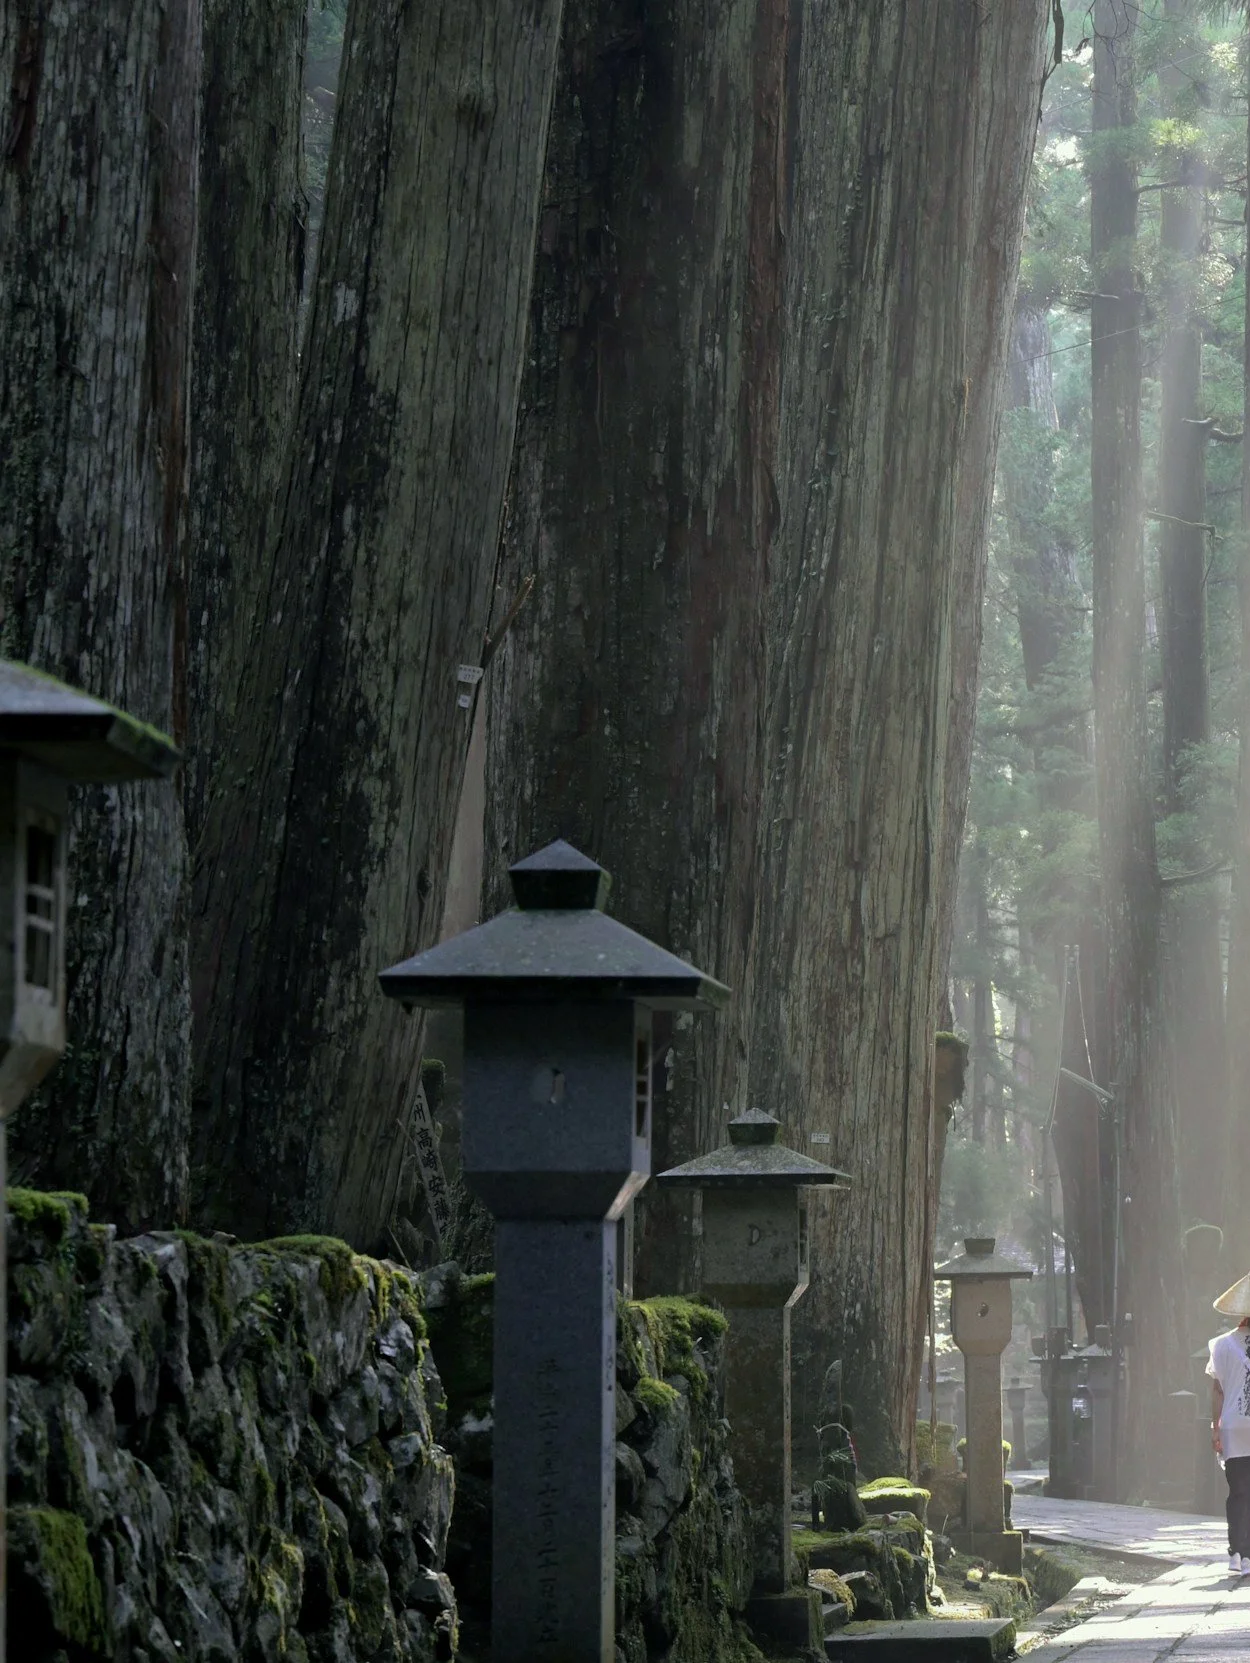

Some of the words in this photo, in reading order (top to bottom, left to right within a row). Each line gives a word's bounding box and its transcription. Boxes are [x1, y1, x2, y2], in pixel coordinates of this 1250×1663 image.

[412, 1094, 449, 1237] 州高崎安藤
